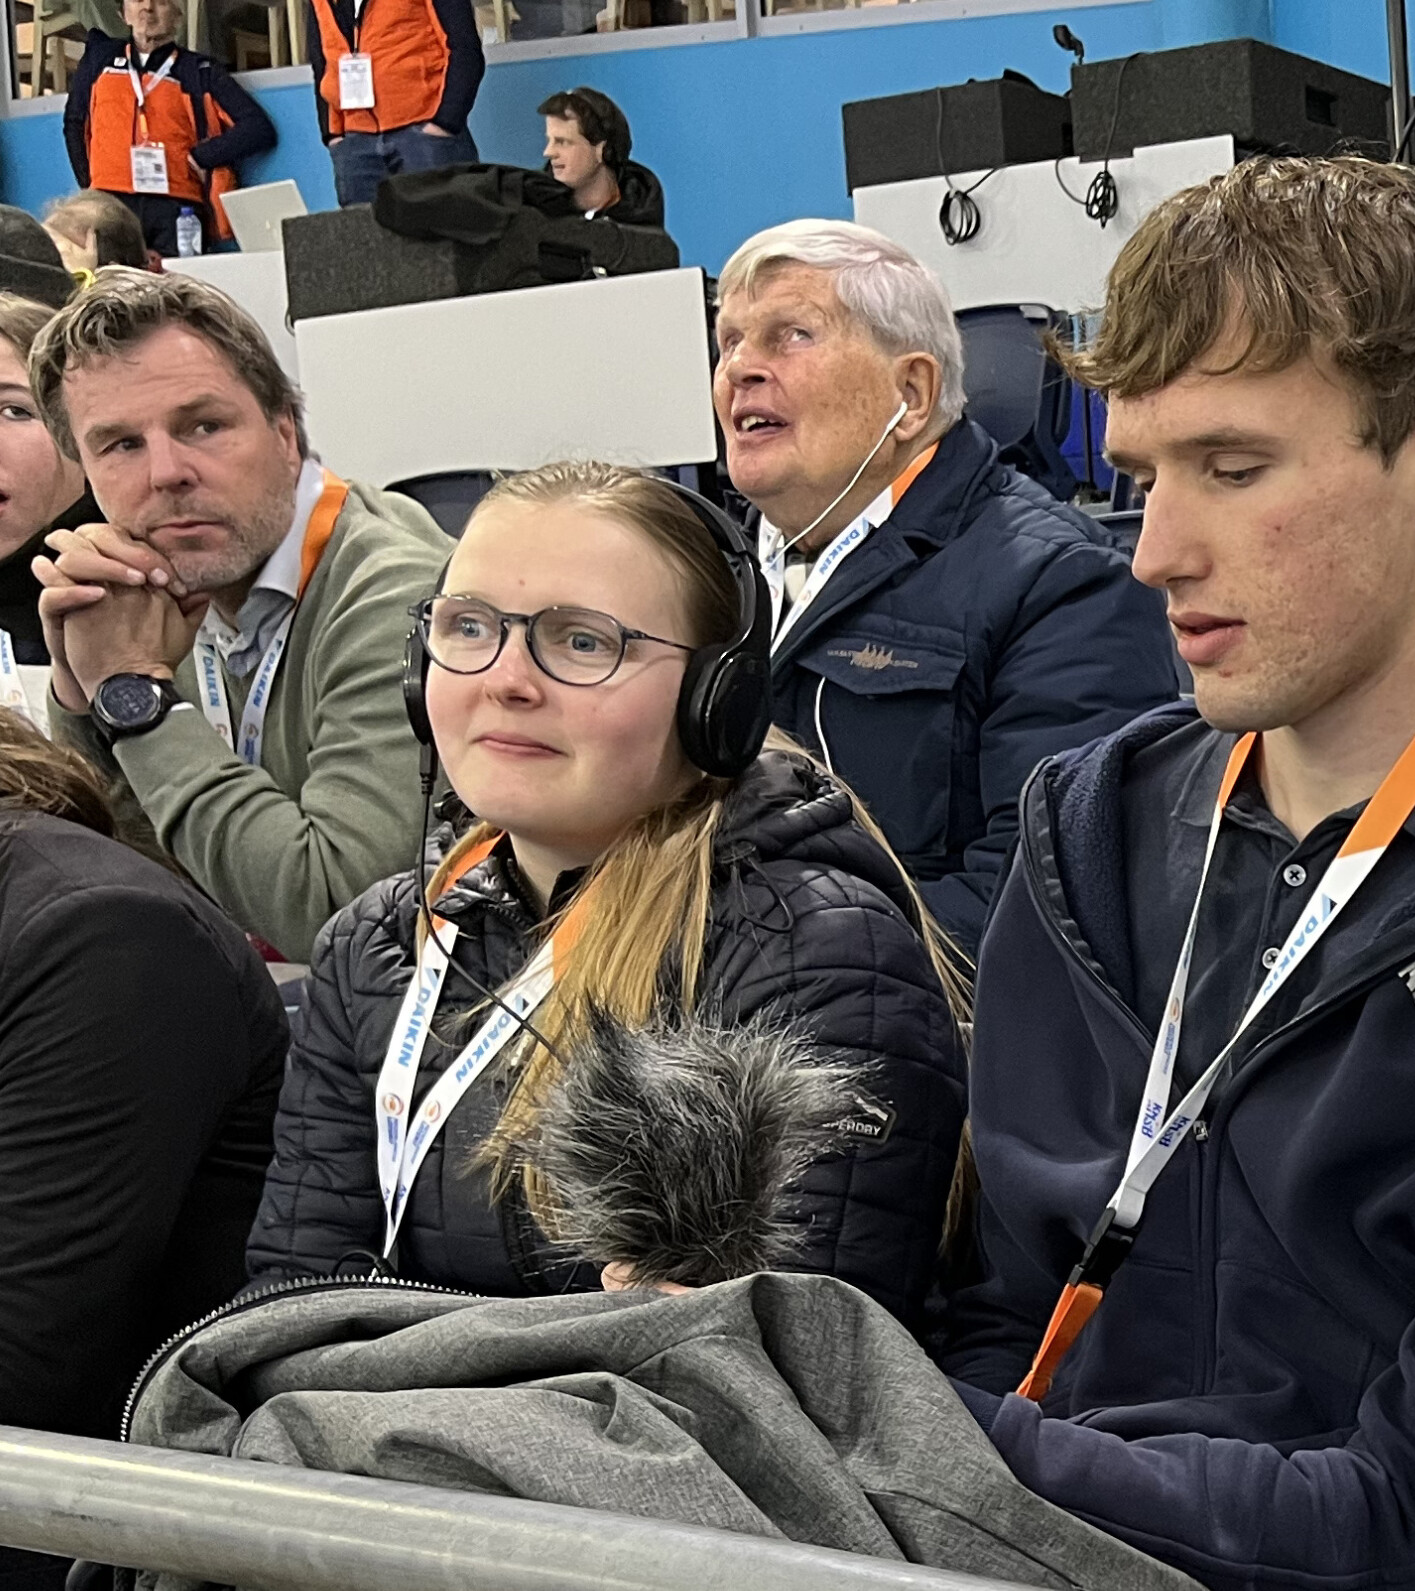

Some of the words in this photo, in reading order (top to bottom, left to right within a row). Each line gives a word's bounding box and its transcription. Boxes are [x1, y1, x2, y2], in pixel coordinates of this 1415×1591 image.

[819, 529, 860, 575] DAIKIN
[202, 656, 220, 706] DAIKIN
[253, 652, 276, 707] DAIKIN
[1263, 915, 1319, 996] DAIKIN
[398, 987, 431, 1067] DAIKIN
[455, 1015, 512, 1083] DAIKIN
